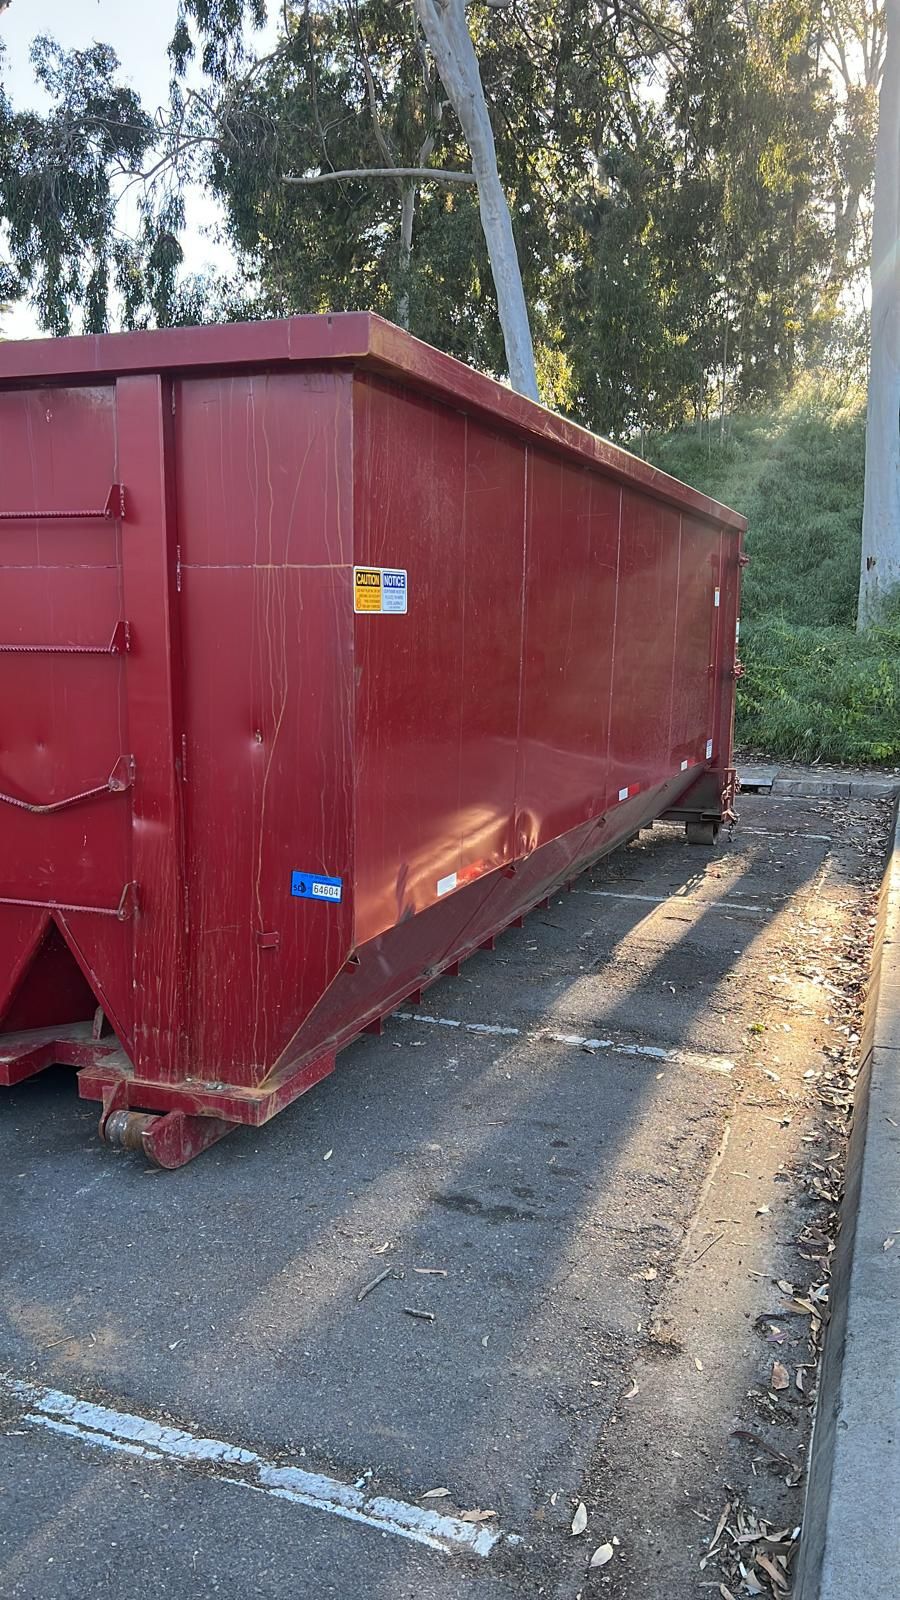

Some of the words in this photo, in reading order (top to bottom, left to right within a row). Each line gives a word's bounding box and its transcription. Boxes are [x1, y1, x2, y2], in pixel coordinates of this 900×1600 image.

[356, 573, 380, 585] CAUTION
[384, 575, 405, 587] NOTICE
[313, 884, 339, 897] 64604
